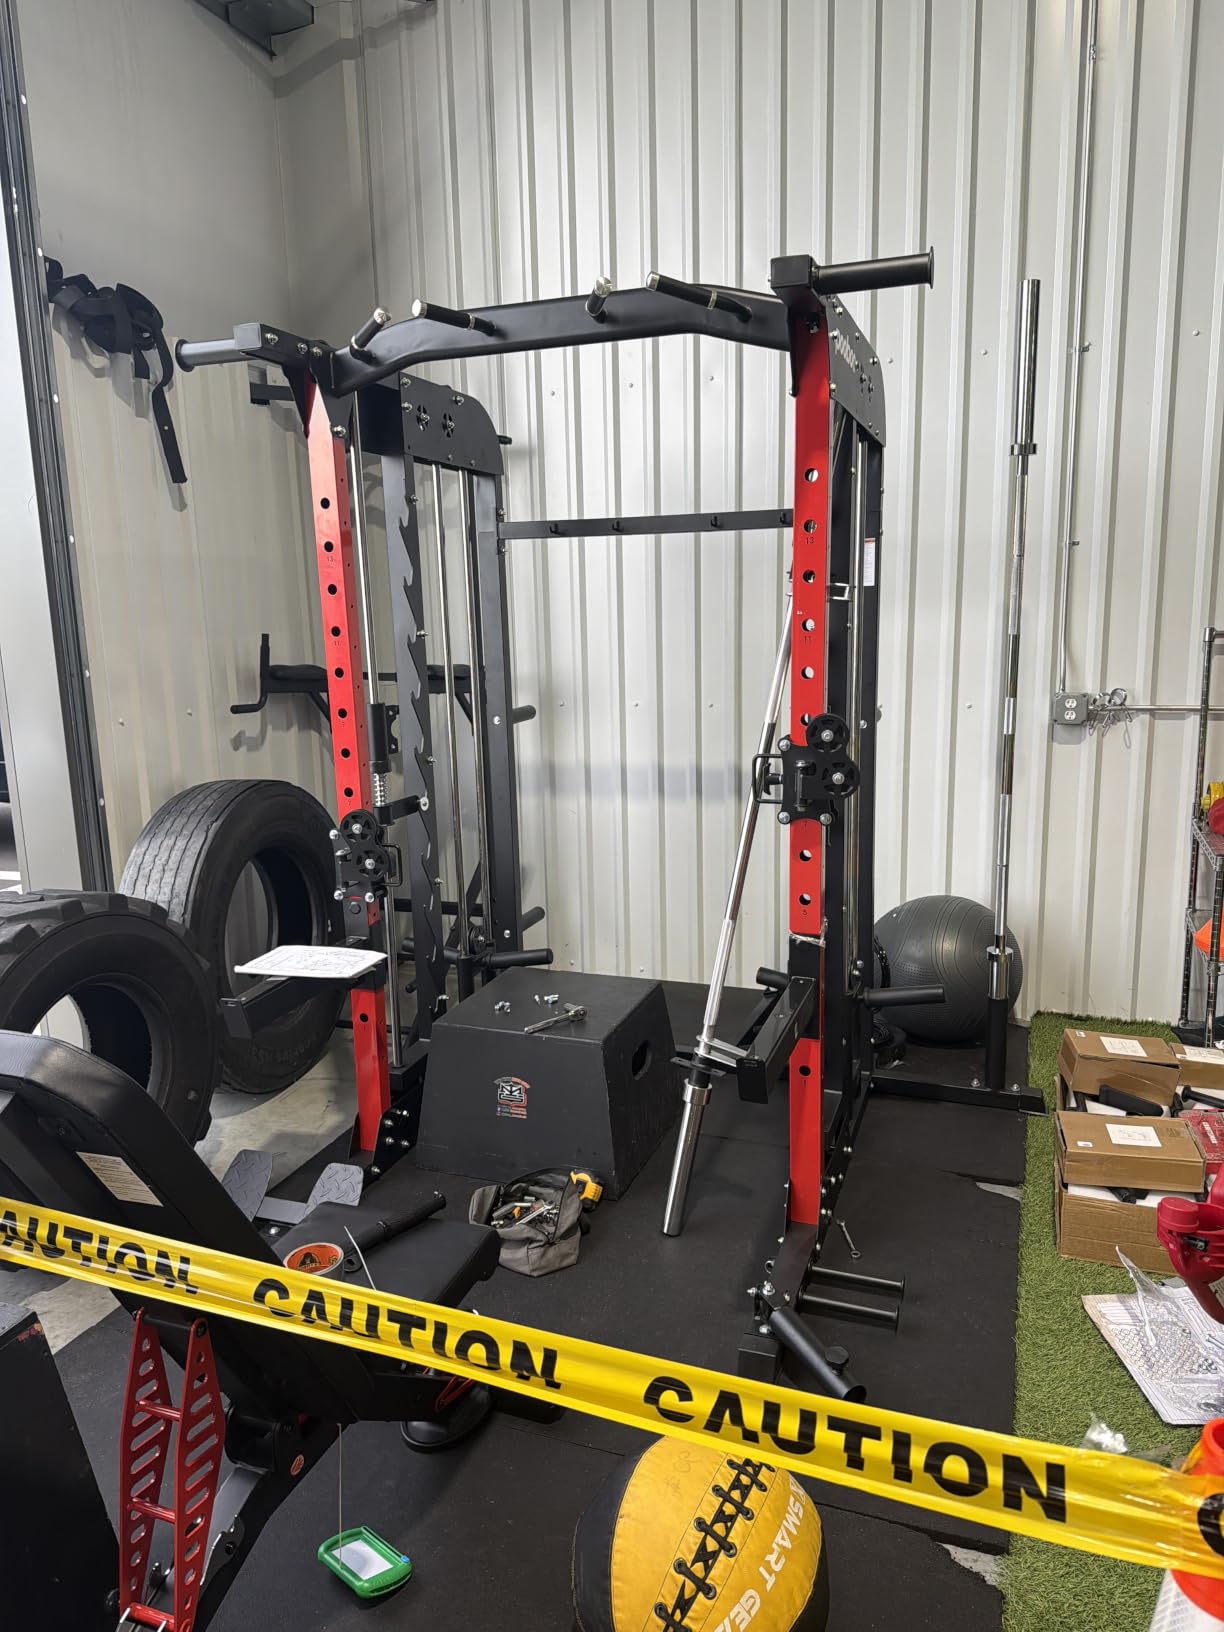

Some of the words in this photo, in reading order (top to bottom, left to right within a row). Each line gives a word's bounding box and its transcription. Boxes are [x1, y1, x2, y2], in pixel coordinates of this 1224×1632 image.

[252, 1278, 562, 1390] CAUTION
[643, 1375, 1068, 1524] CAUTION
[758, 1493, 804, 1592] SMART
